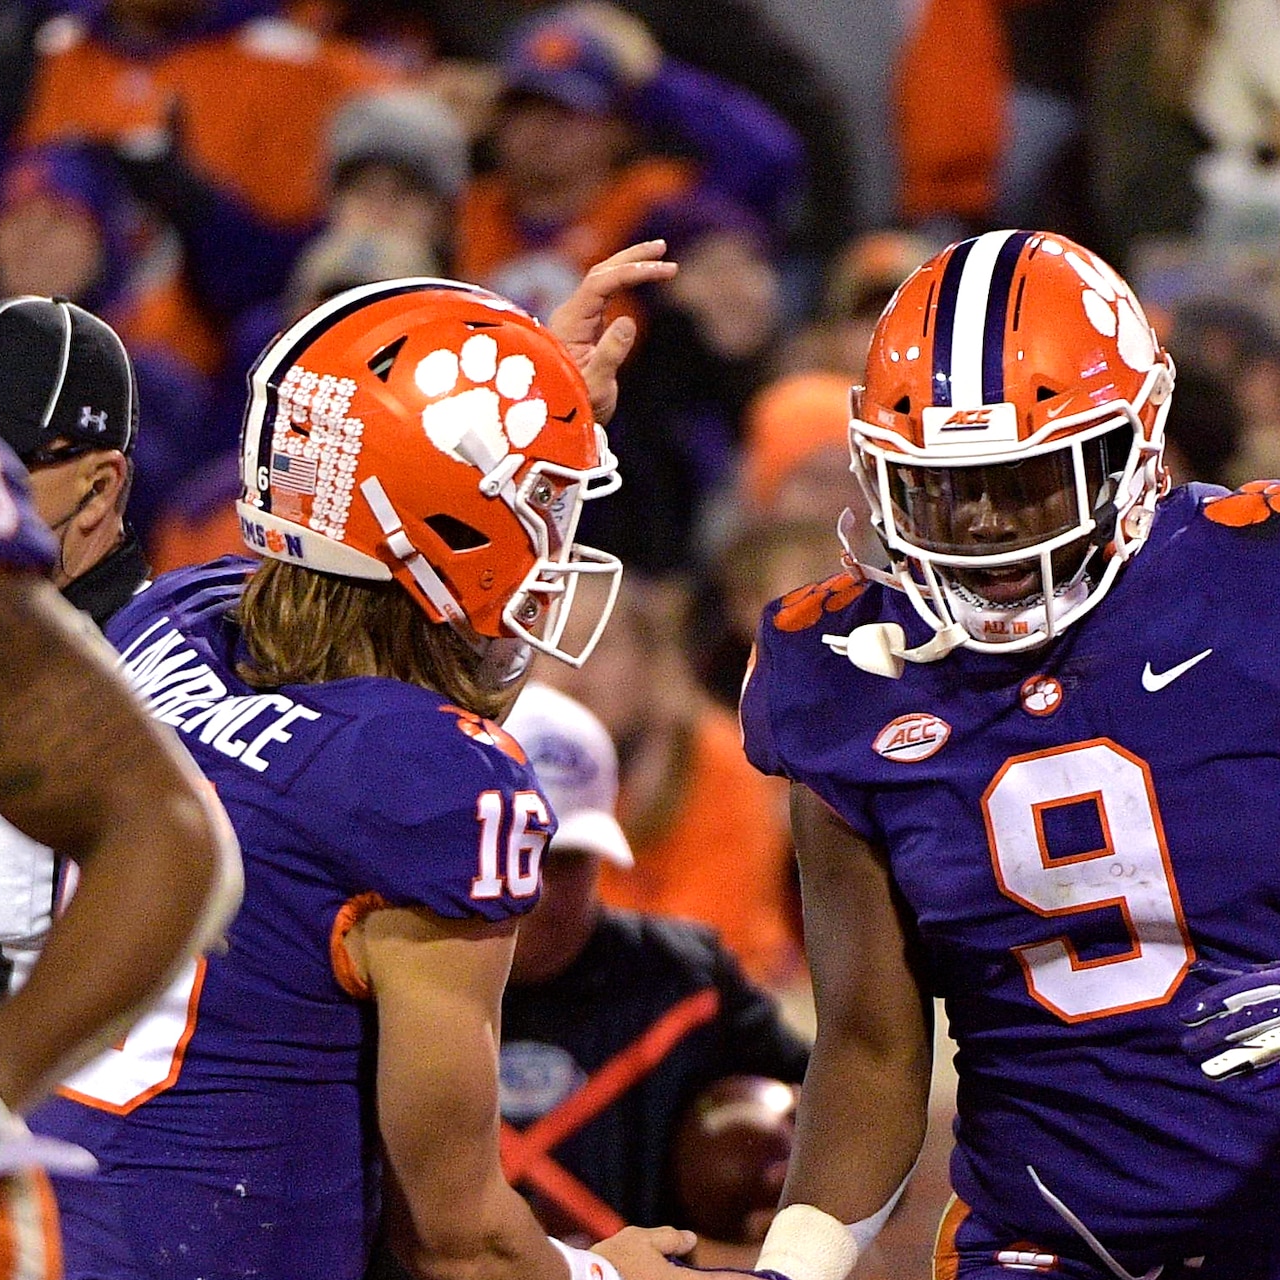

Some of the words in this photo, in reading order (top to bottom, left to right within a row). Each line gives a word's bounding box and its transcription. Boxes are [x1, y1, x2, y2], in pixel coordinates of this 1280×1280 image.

[942, 409, 993, 425] ACC
[983, 621, 1010, 634] ALL
[886, 721, 937, 748] ACC
[470, 789, 551, 899] 16
[981, 738, 1197, 1024] 9
